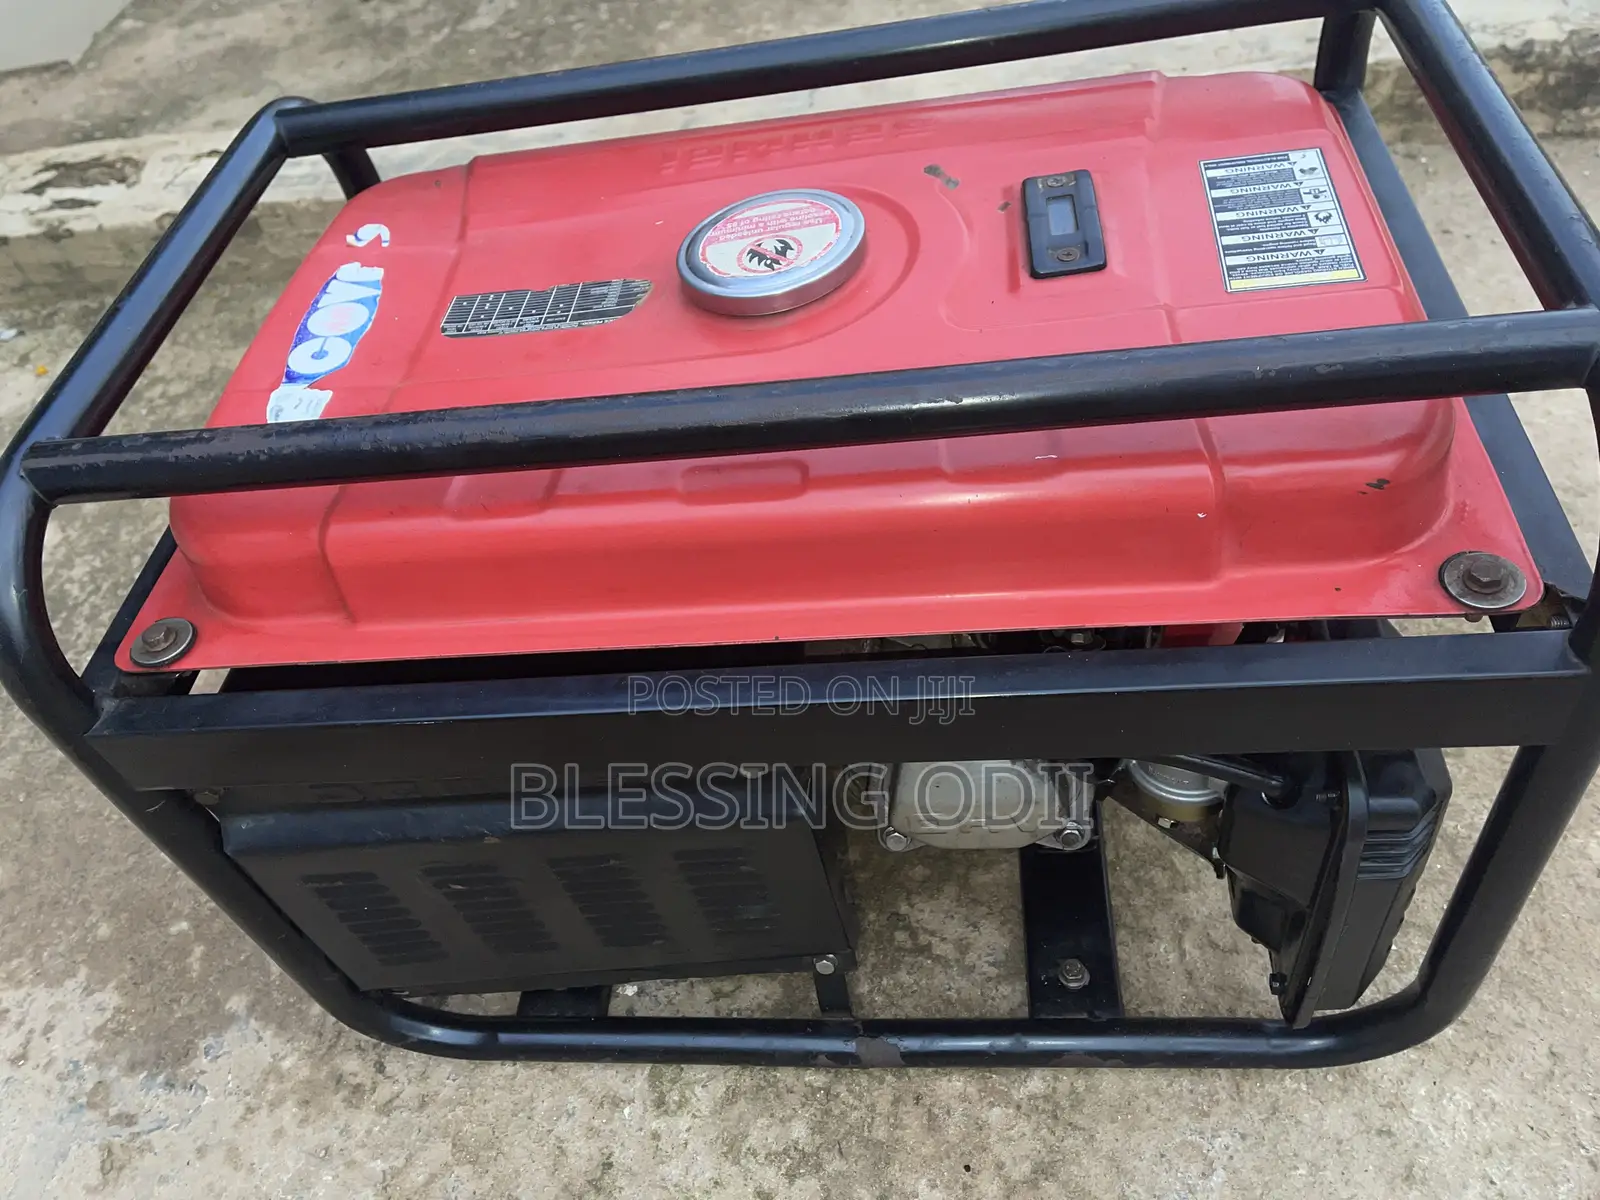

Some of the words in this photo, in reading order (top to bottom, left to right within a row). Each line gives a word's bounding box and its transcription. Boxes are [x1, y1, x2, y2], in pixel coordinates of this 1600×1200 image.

[1224, 162, 1285, 173] WARNING
[1229, 182, 1291, 194] WARNING
[1234, 205, 1299, 217] WARNING
[1240, 229, 1306, 242] WARNING
[1245, 249, 1312, 262] WARNING
